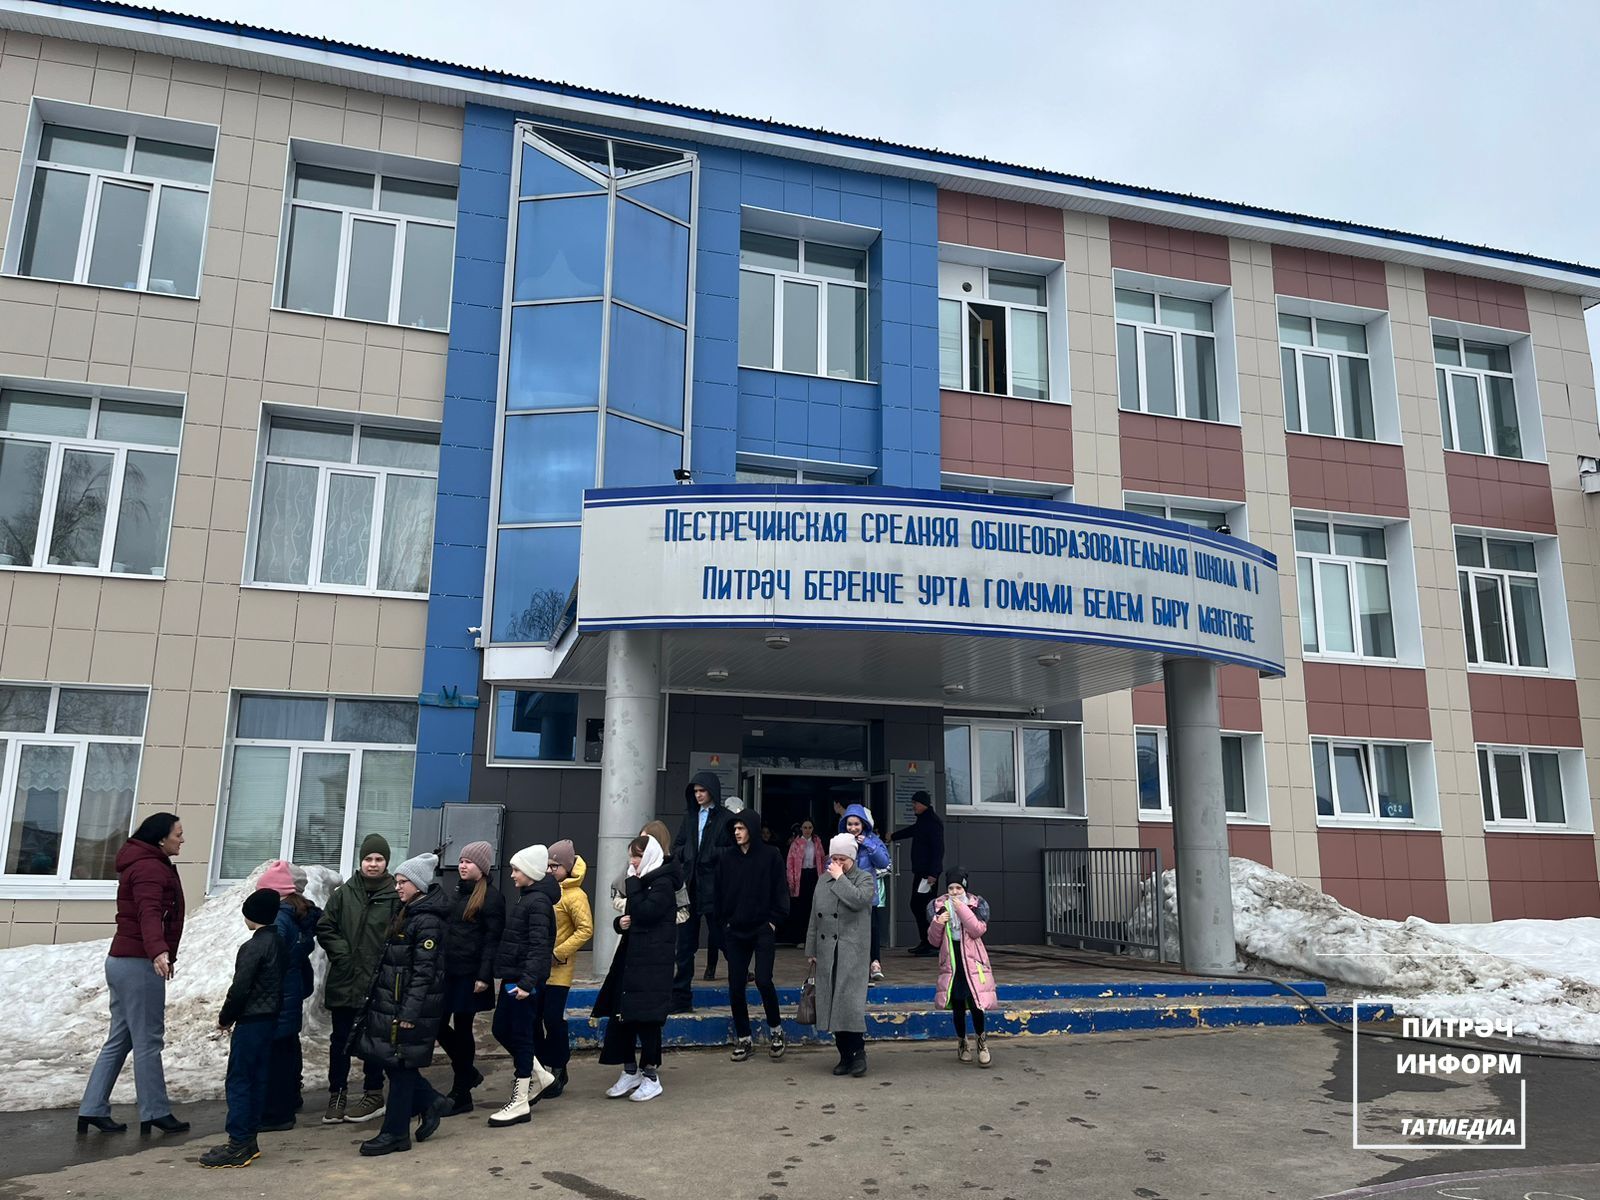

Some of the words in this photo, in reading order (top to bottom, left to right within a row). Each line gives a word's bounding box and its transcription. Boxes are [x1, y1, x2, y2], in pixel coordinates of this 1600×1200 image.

[664, 508, 848, 543] ПЕСТРЕЧИНСКАЯ
[861, 512, 960, 548] СРЕДНЯЯ
[971, 519, 1189, 576] ОБЩЕОБРАЗОВАТЕЛЬНАЯ
[1194, 551, 1238, 588] ШКОЛА
[702, 565, 791, 600] ПИТРӘЧ
[804, 570, 904, 605] БЕРЕНЧЕ
[918, 575, 970, 608] УРТА
[983, 578, 1073, 616] ГОМУМИ
[1083, 587, 1144, 624] БЕЛЕМ
[1197, 603, 1256, 643] МӘКТӘБЕ
